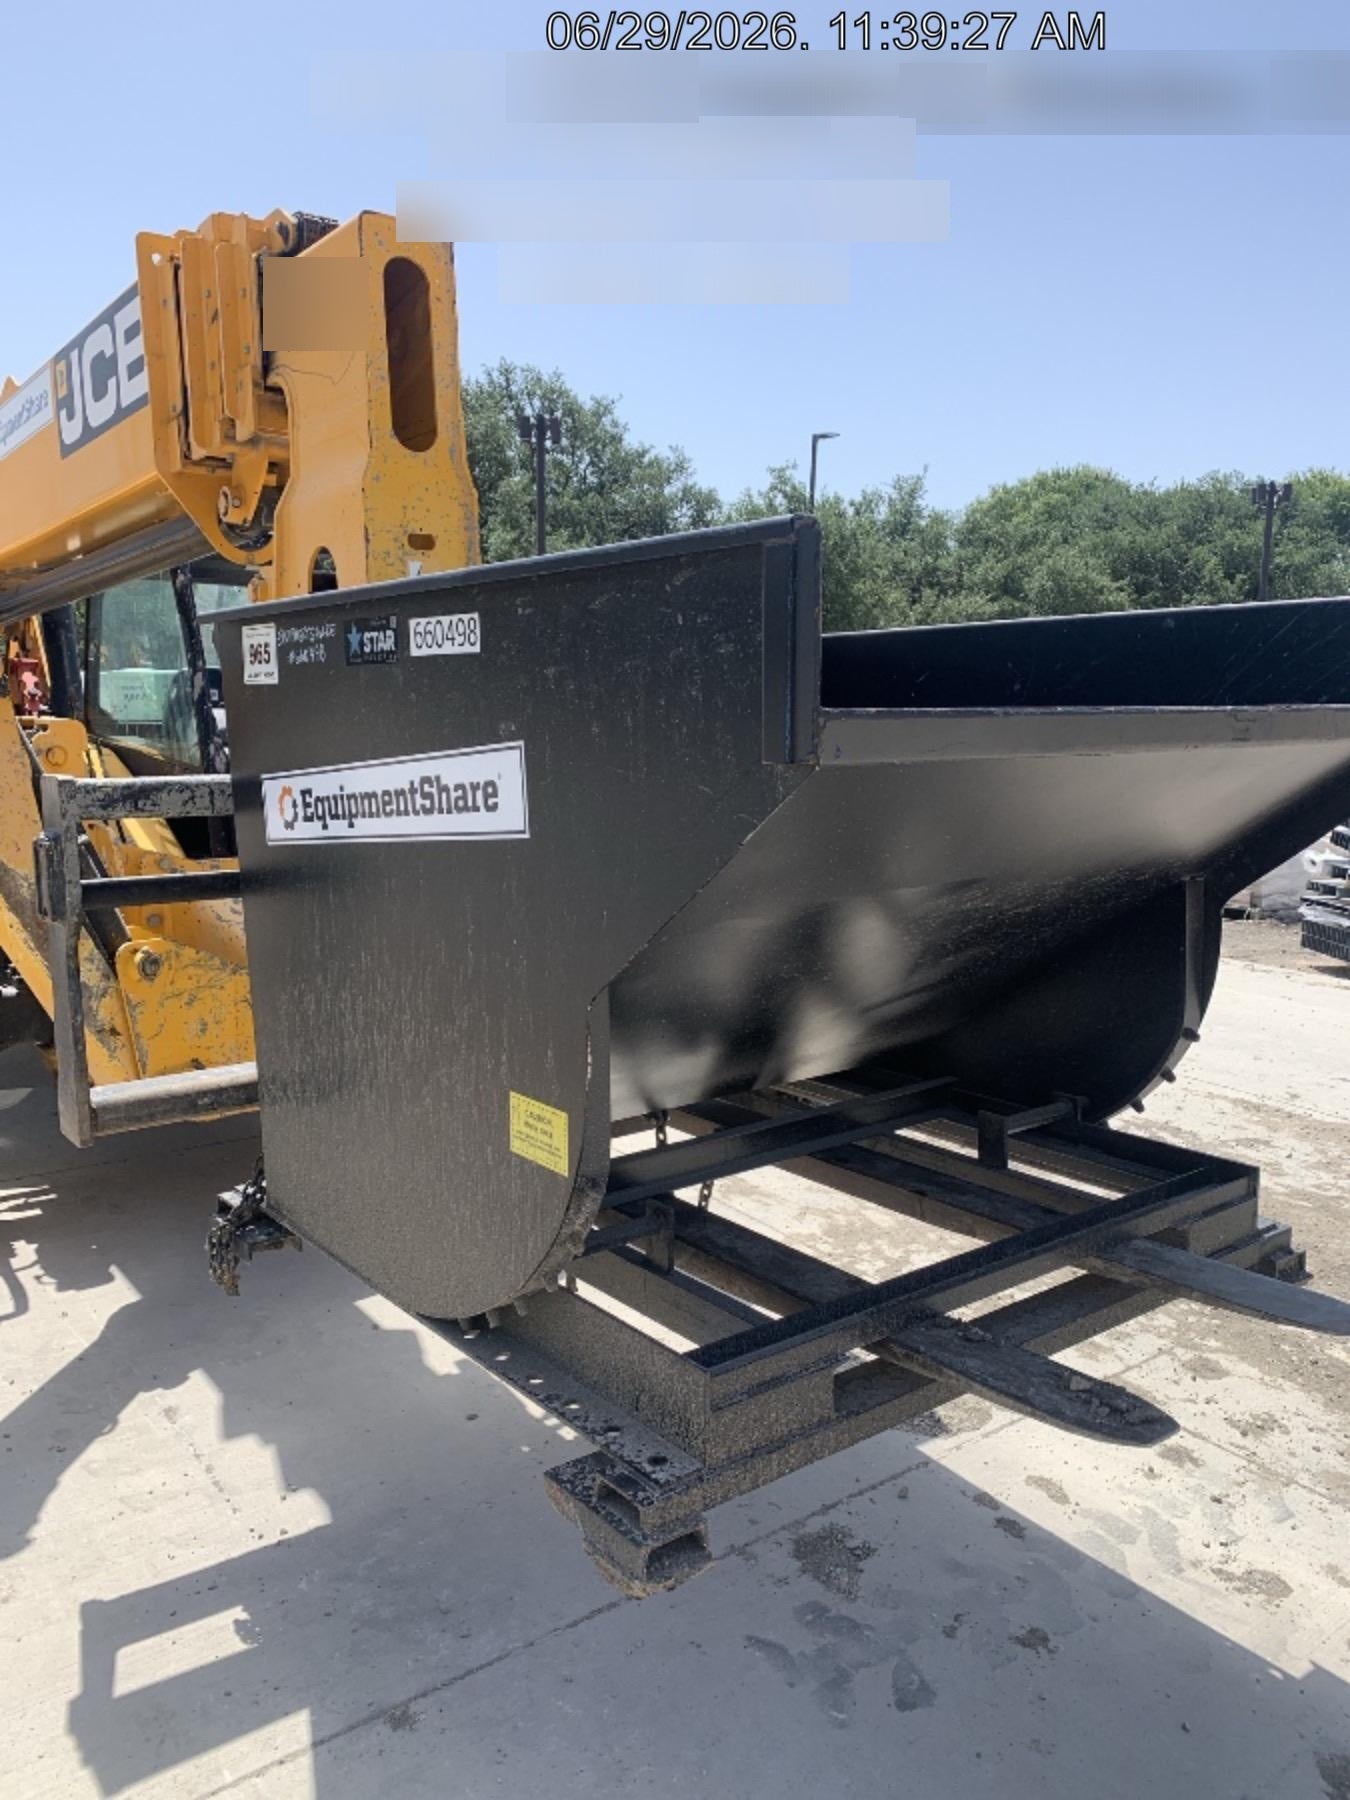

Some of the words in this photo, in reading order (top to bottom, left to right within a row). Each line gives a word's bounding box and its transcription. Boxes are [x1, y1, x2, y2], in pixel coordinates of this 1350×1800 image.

[363, 629, 396, 653] STAR
[413, 616, 478, 649] 660498
[301, 773, 500, 831] EquipmentShare
